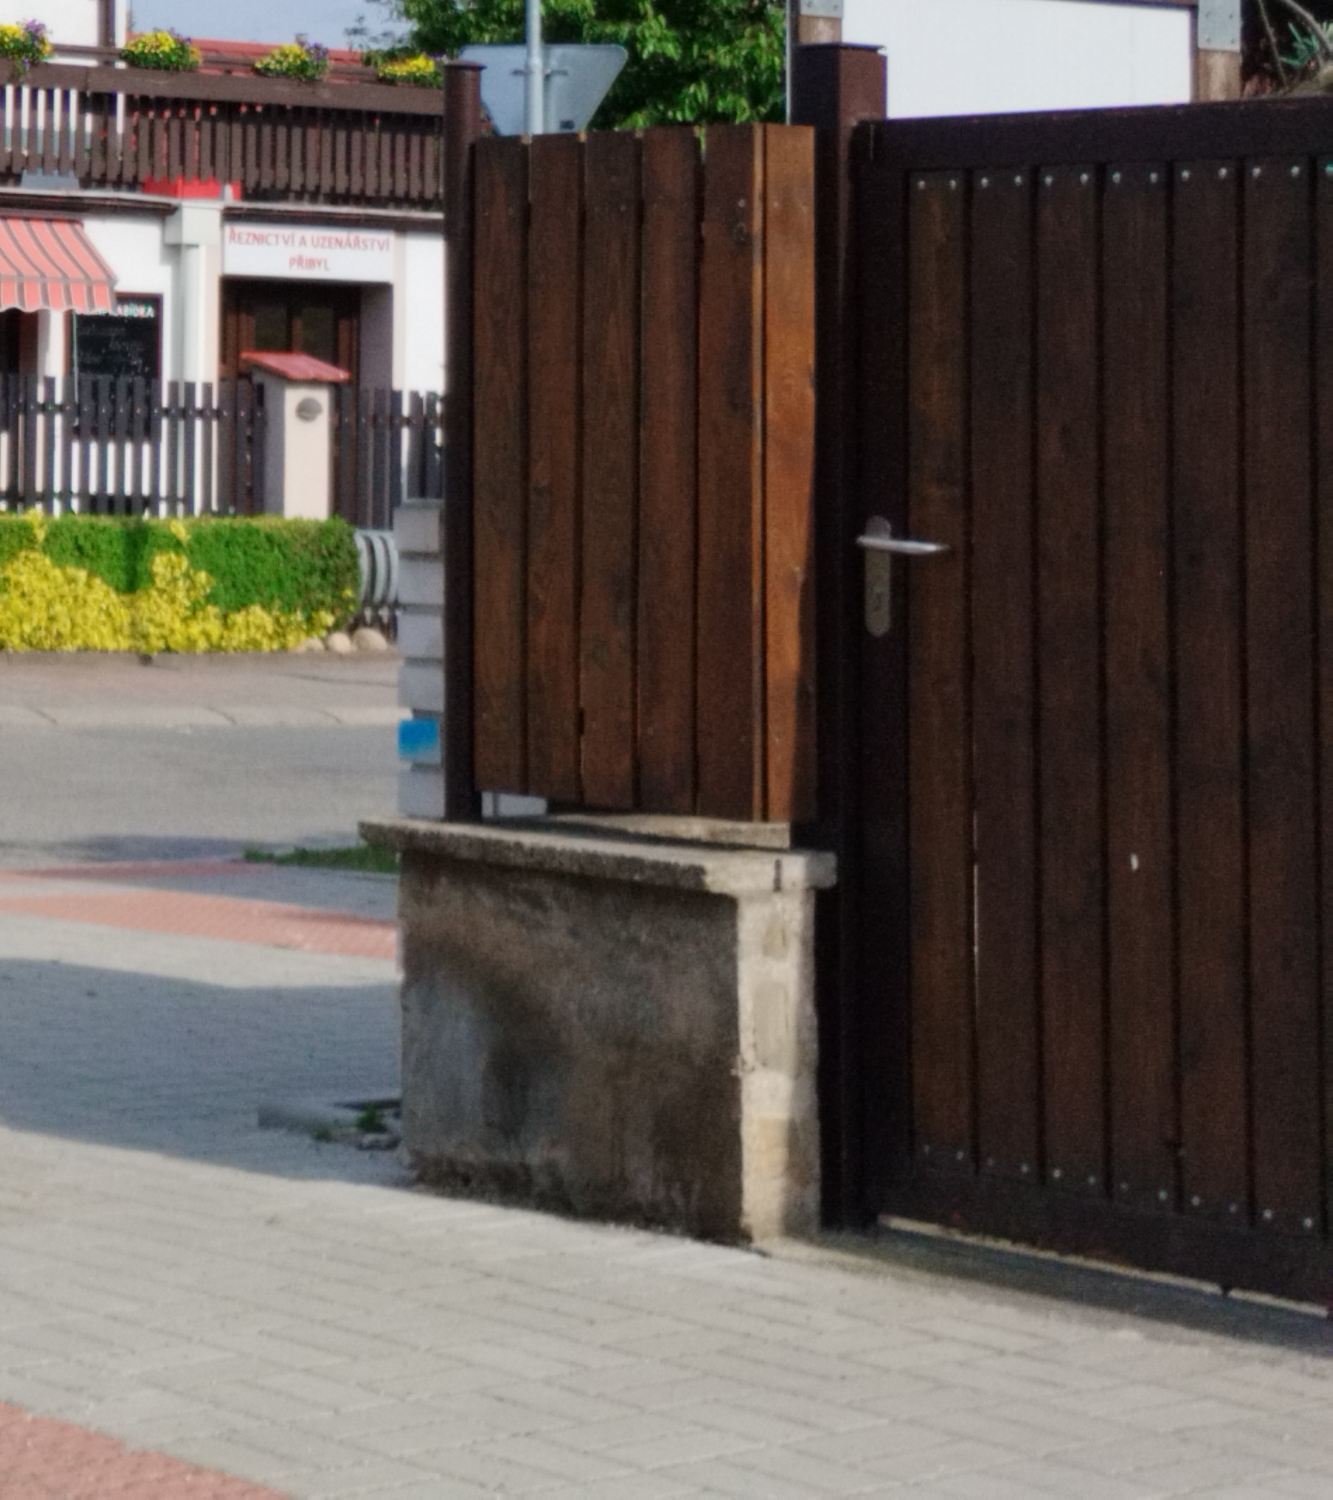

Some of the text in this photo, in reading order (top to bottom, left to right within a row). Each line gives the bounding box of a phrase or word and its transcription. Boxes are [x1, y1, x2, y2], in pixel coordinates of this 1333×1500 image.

[228, 225, 390, 251] ŘEZNICTVÍ A UZENÁŘSTVÍ
[289, 255, 330, 271] PŘIBYL
